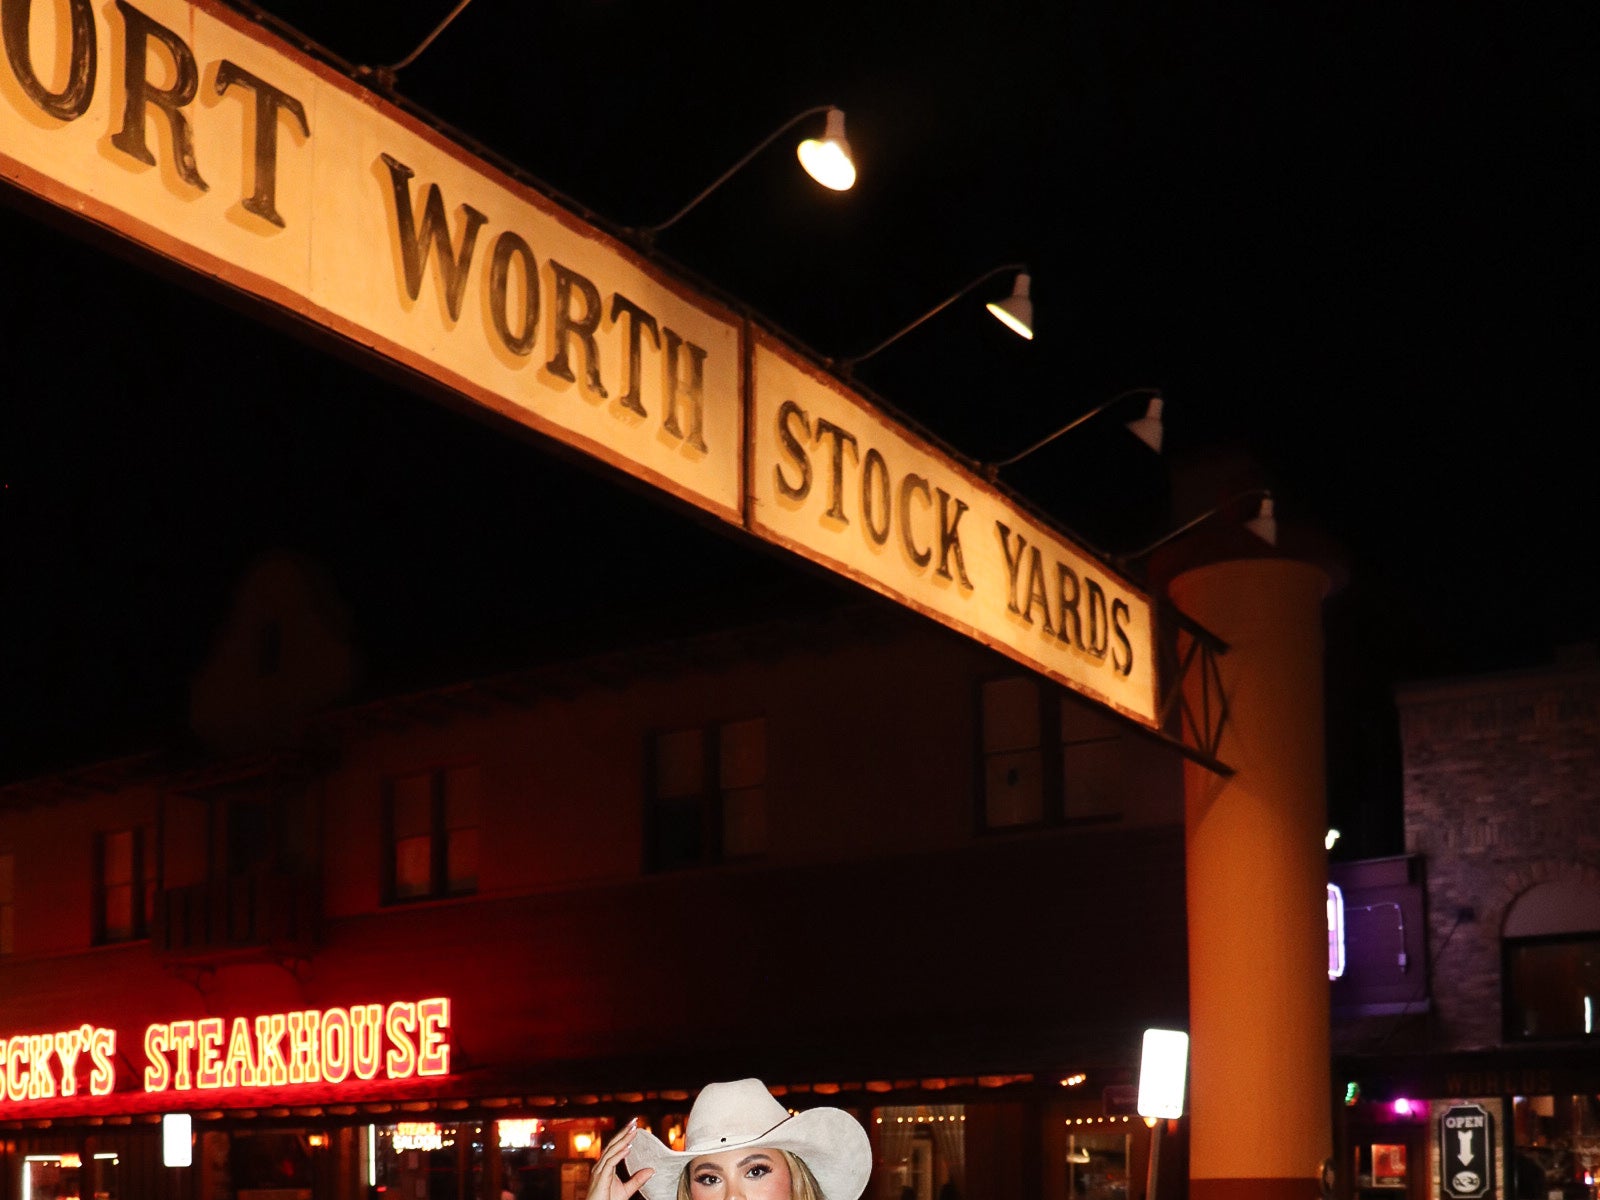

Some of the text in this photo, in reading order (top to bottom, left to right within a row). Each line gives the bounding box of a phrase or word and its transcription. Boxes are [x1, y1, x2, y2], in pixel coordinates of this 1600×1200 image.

[377, 152, 709, 456] WORTH
[774, 400, 974, 592] STOCK
[995, 520, 1134, 678] YARDS
[0, 997, 452, 1101] CKY'S STEAKHOUSE
[393, 1135, 442, 1149] SALOON
[1446, 1116, 1484, 1129] OPEN
